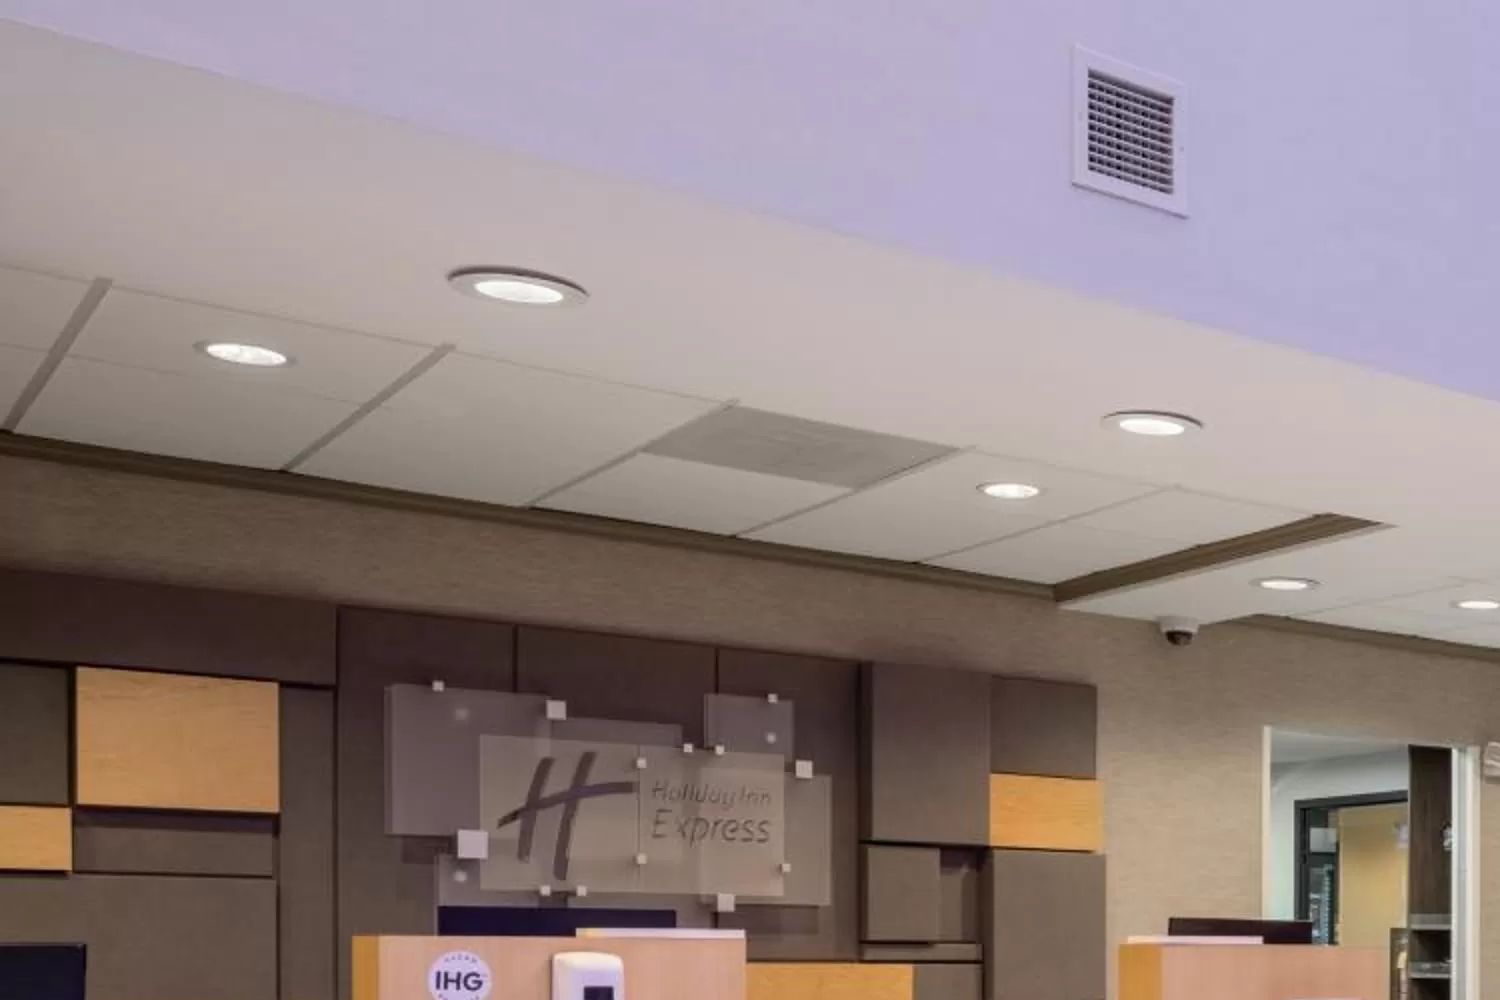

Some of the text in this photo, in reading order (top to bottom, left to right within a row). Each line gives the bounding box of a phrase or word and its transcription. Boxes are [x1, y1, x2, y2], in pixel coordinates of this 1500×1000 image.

[651, 780, 737, 810] Holiday
[651, 808, 772, 848] Express
[435, 970, 483, 992] IHG
